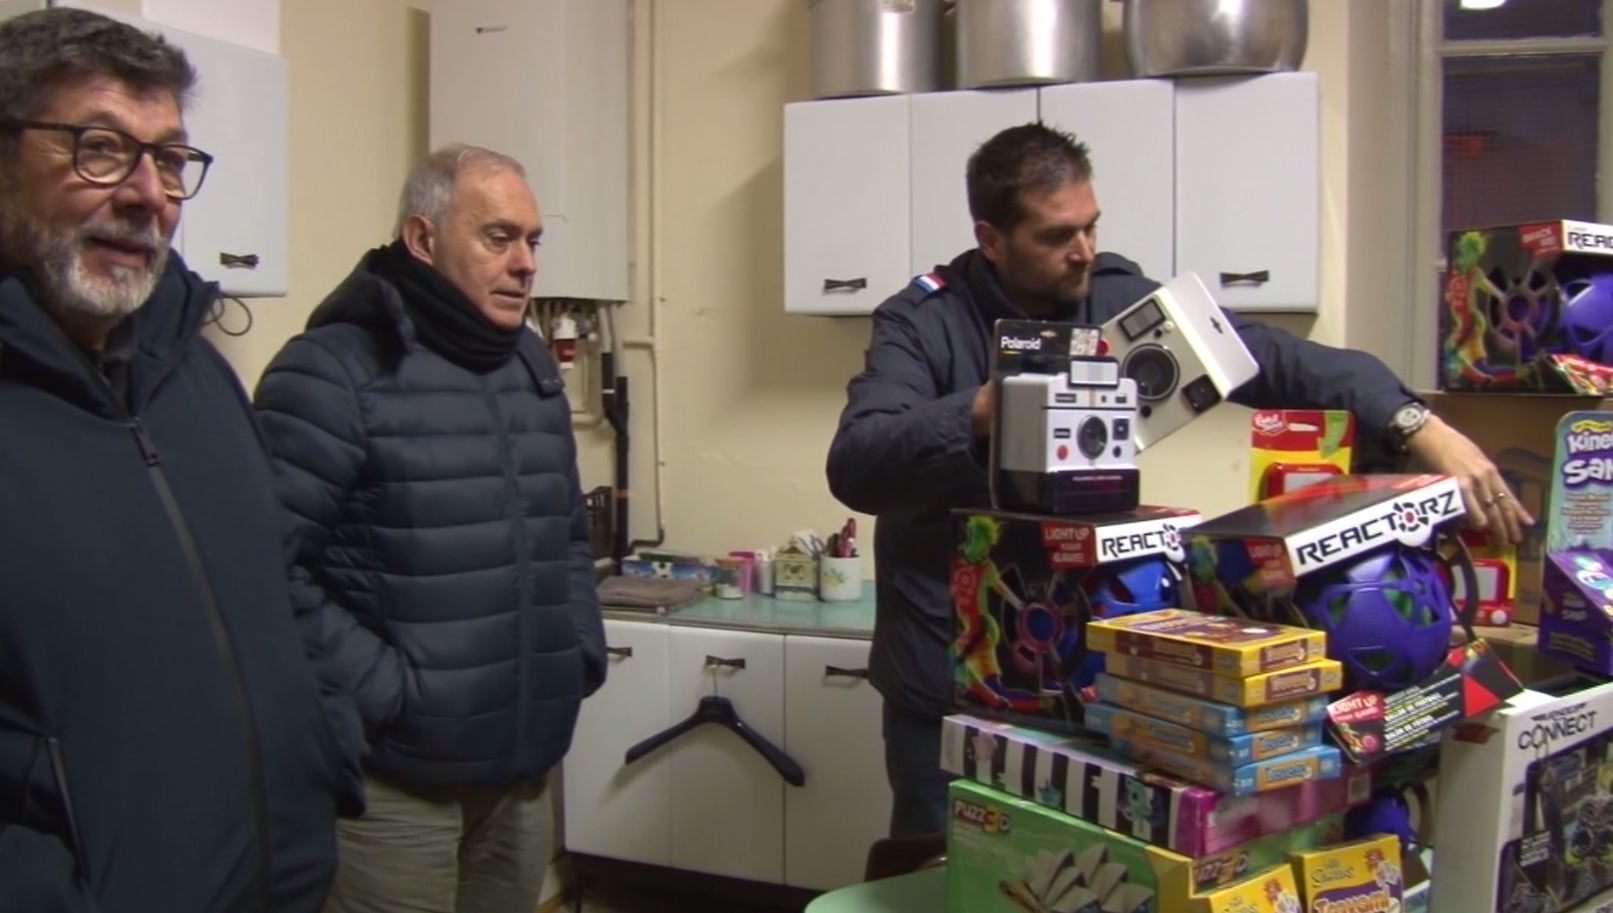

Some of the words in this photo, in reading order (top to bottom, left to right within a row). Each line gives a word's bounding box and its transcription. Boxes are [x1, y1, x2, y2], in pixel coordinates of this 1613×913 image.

[1000, 335, 1042, 350] Polaroid
[1044, 527, 1074, 541] LIGHT
[1075, 526, 1090, 541] UP
[1296, 489, 1459, 566] REACTORZ
[1518, 710, 1597, 750] CONNECT
